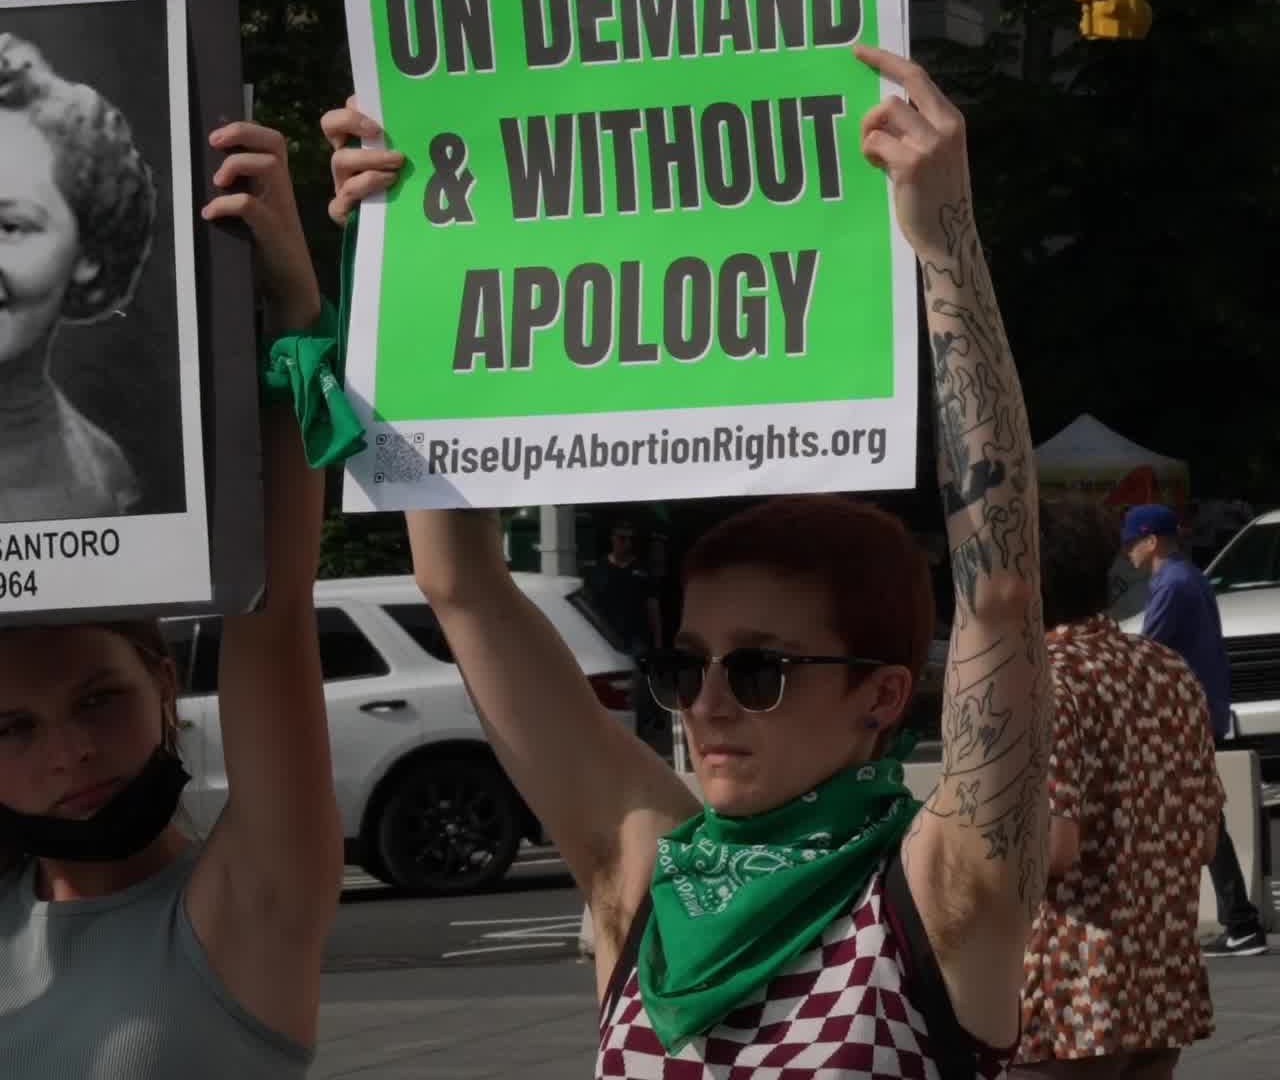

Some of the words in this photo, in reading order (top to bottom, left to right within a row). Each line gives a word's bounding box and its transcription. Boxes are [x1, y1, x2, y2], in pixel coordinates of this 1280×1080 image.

[424, 132, 475, 225] &
[500, 95, 844, 221] WITHOUT
[453, 249, 818, 373] APOLOGY
[428, 424, 887, 479] RiseUp4AbortionRights.org
[0, 528, 120, 562] ANTORO
